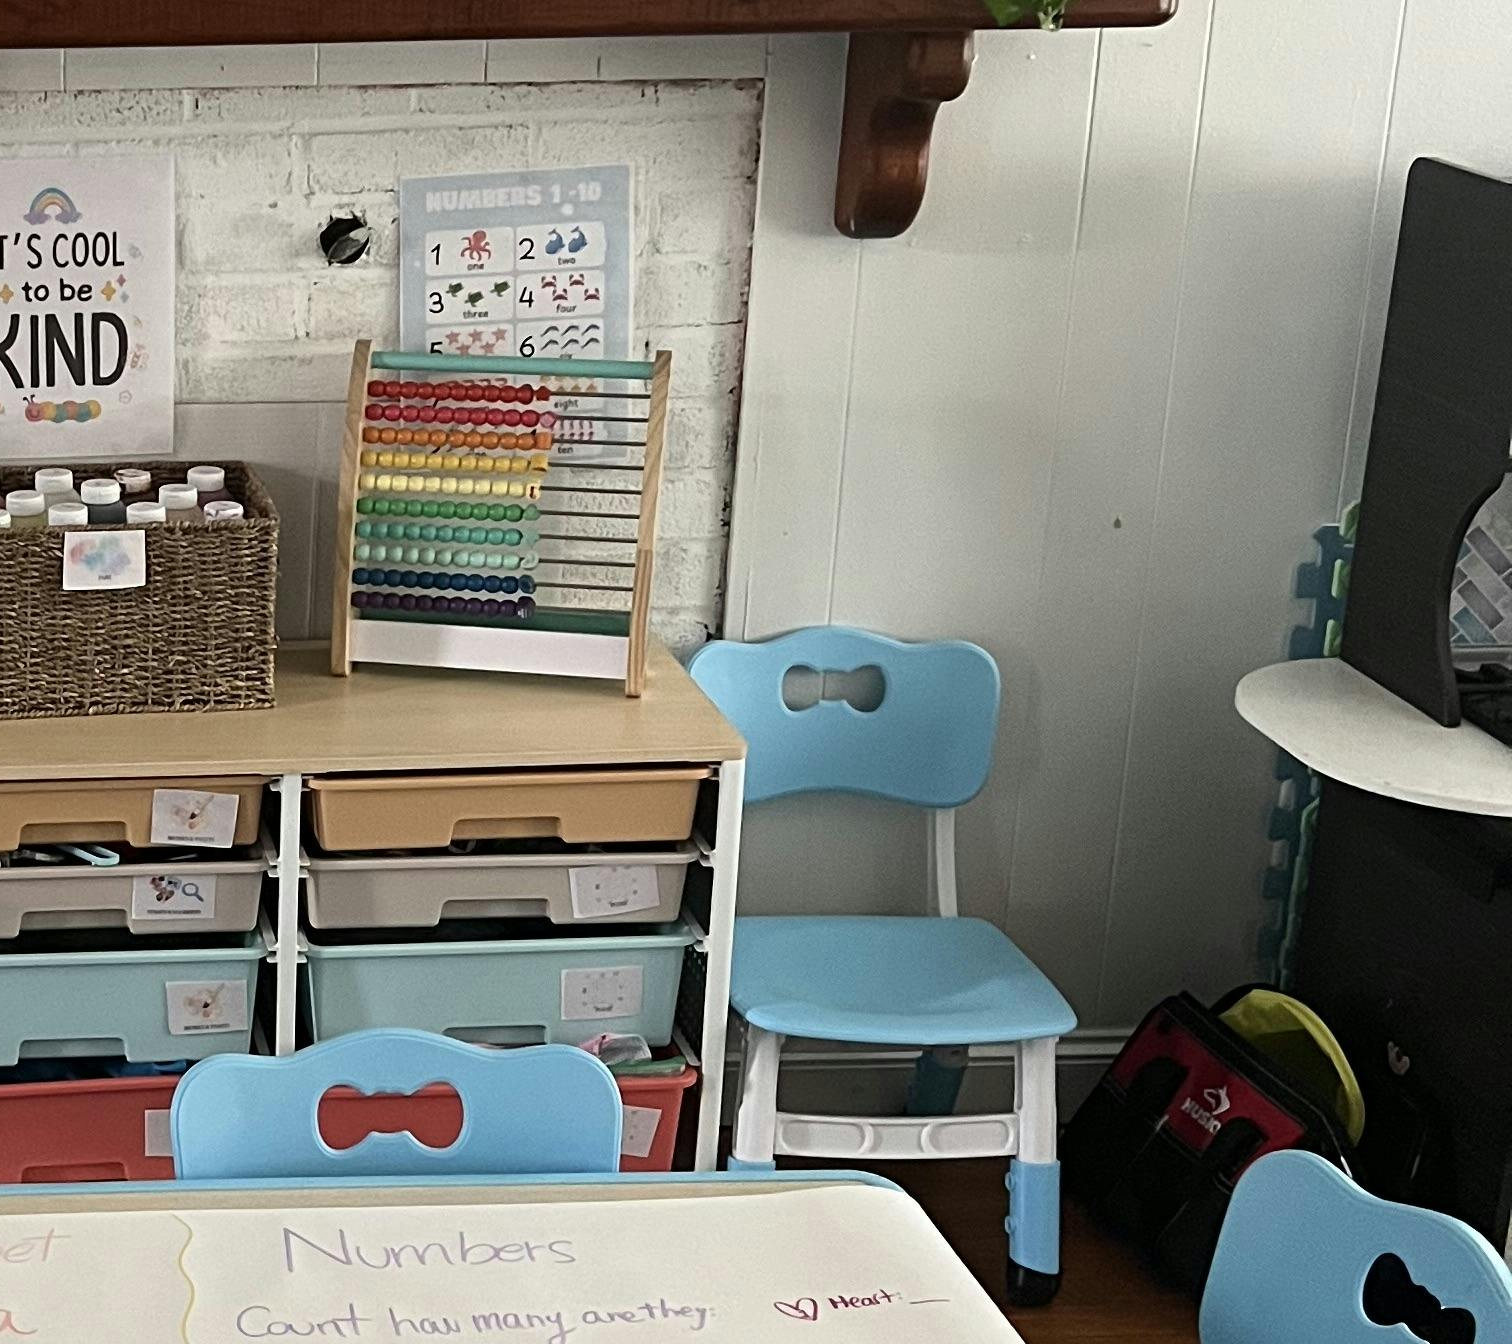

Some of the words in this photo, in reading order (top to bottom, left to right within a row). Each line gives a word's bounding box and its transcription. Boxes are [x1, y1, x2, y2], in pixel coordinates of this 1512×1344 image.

[425, 184, 542, 213] NUMBERS
[52, 231, 125, 268] COOL
[431, 244, 442, 265] 1
[518, 238, 535, 261] 2
[558, 256, 576, 265] two
[467, 262, 485, 271] one
[22, 281, 49, 302] to
[60, 278, 93, 301] be
[519, 287, 534, 308] 4
[429, 292, 444, 314] 3
[463, 309, 489, 319] three
[556, 304, 577, 314] four
[519, 336, 535, 358] 6
[554, 399, 579, 411] eight
[557, 446, 574, 454] ten
[1181, 1097, 1222, 1135] HUSK
[283, 1227, 577, 1272] Numbers
[237, 1302, 371, 1338] Count
